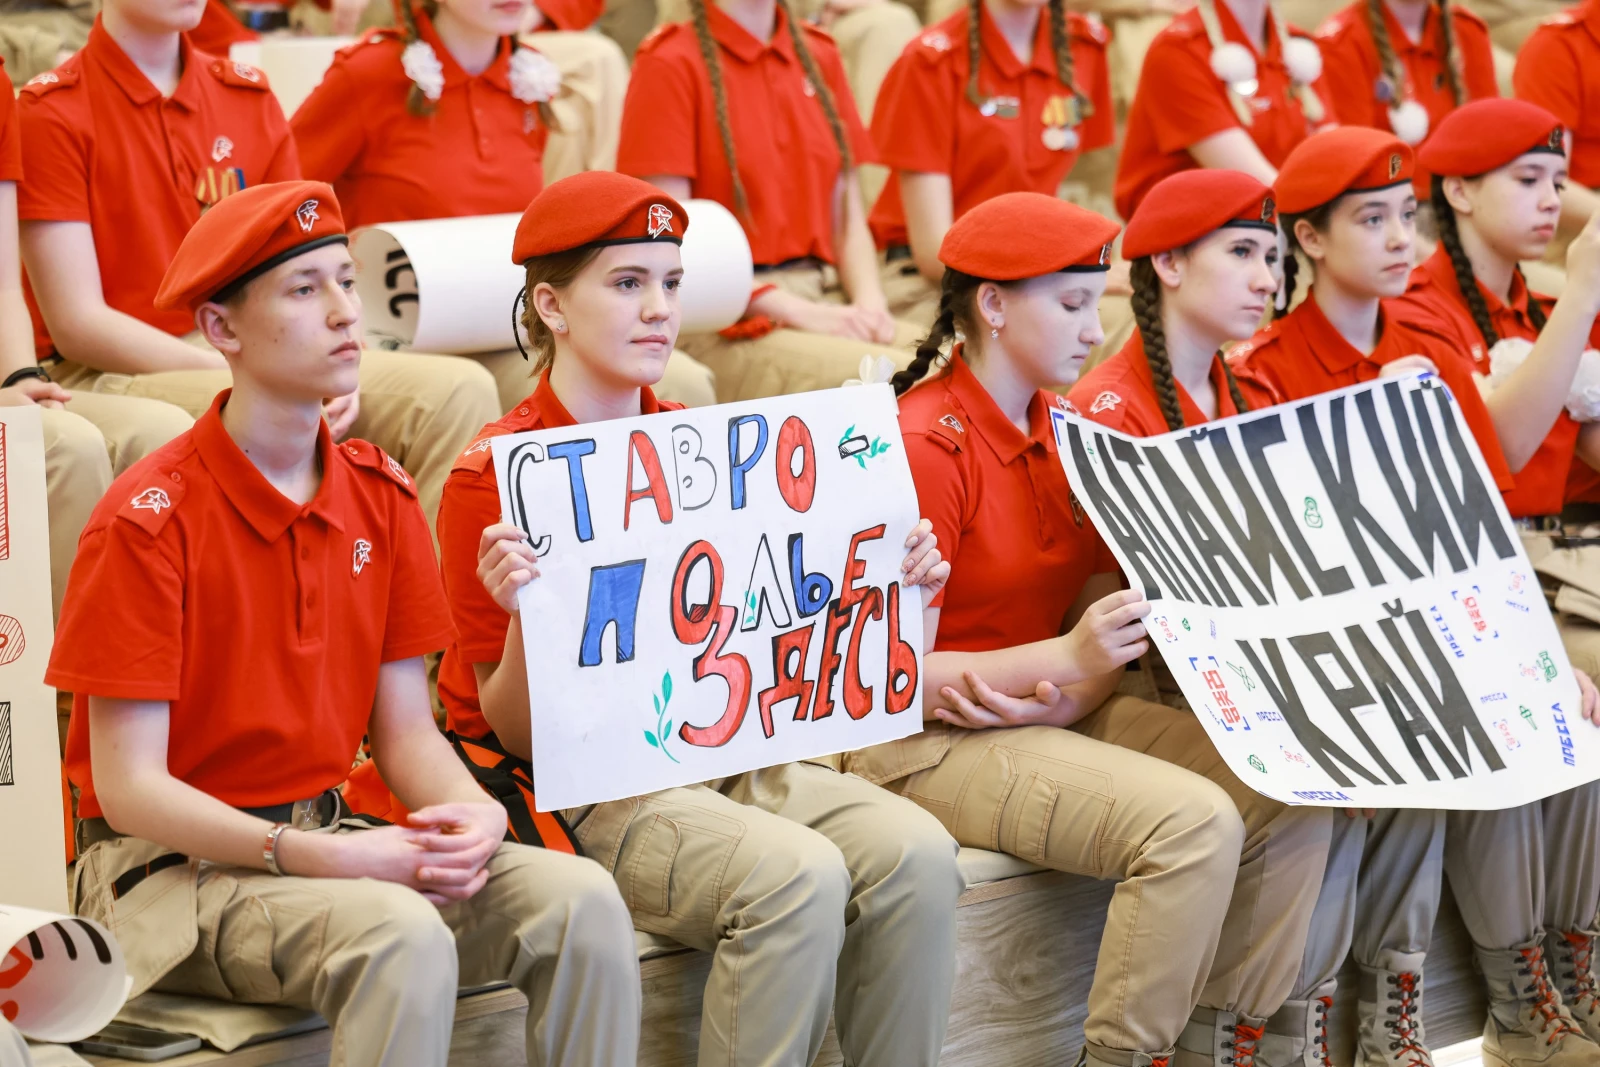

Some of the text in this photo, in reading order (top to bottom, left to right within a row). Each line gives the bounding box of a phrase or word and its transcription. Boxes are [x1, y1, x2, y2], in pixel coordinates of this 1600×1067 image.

[1066, 379, 1517, 608] АЛТАЙСКИЙ
[578, 523, 887, 668] ПОЛЬЕ
[678, 582, 918, 748] ЗДЕСЬ
[1429, 606, 1465, 658] ПРЕССА
[1234, 597, 1508, 788] КРАЙ
[1551, 702, 1575, 767] ПРЕССА
